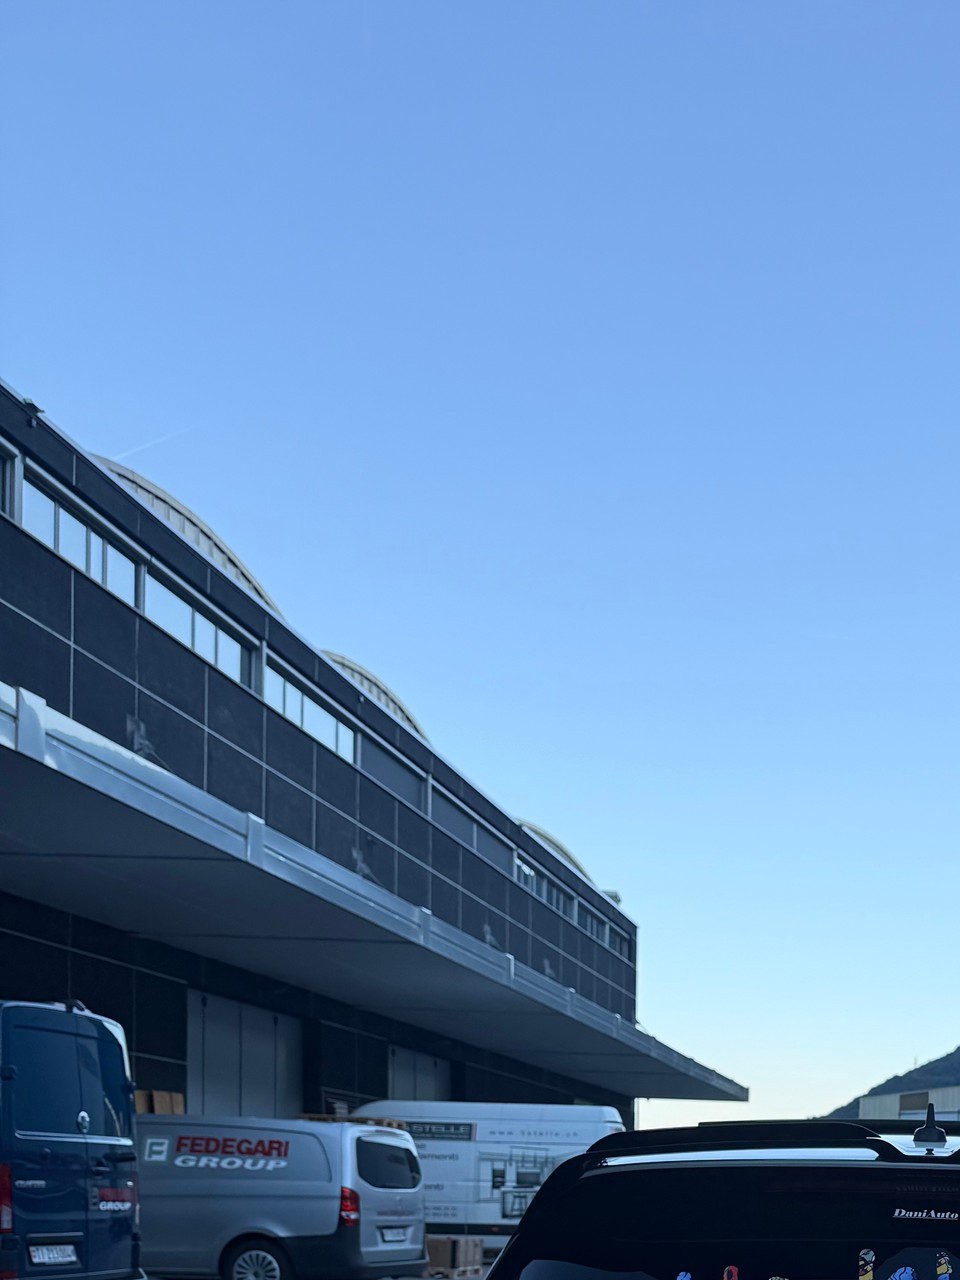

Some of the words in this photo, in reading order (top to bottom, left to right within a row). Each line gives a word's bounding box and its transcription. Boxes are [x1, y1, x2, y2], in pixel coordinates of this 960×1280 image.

[175, 1135, 290, 1159] FEDEGARI
[174, 1154, 288, 1171] GROUP
[99, 1201, 132, 1211] GROUP
[892, 1208, 959, 1220] DaniAuto
